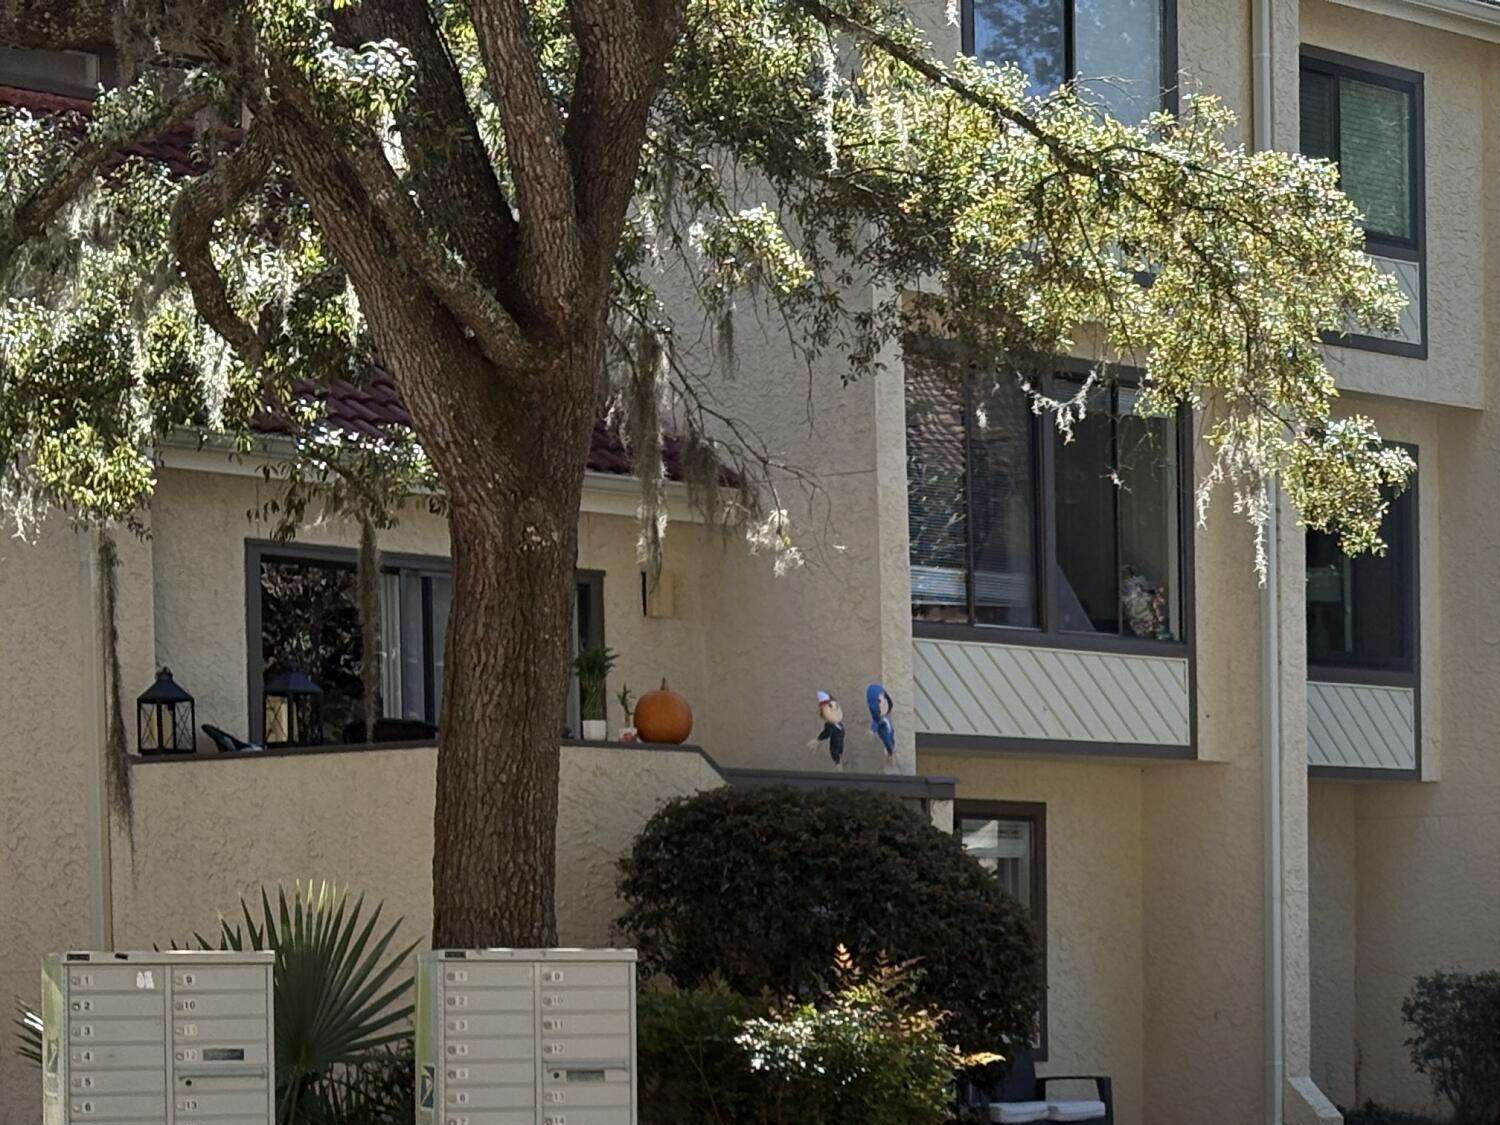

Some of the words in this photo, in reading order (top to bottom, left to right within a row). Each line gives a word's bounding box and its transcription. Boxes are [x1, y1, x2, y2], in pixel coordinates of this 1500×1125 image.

[185, 1001, 196, 1010] 10
[554, 1020, 563, 1029] 11
[554, 1044, 564, 1053] 12
[186, 1051, 196, 1060] 12
[555, 1093, 564, 1101] 13
[187, 1100, 197, 1110] 13
[555, 1117, 564, 1125] 14
